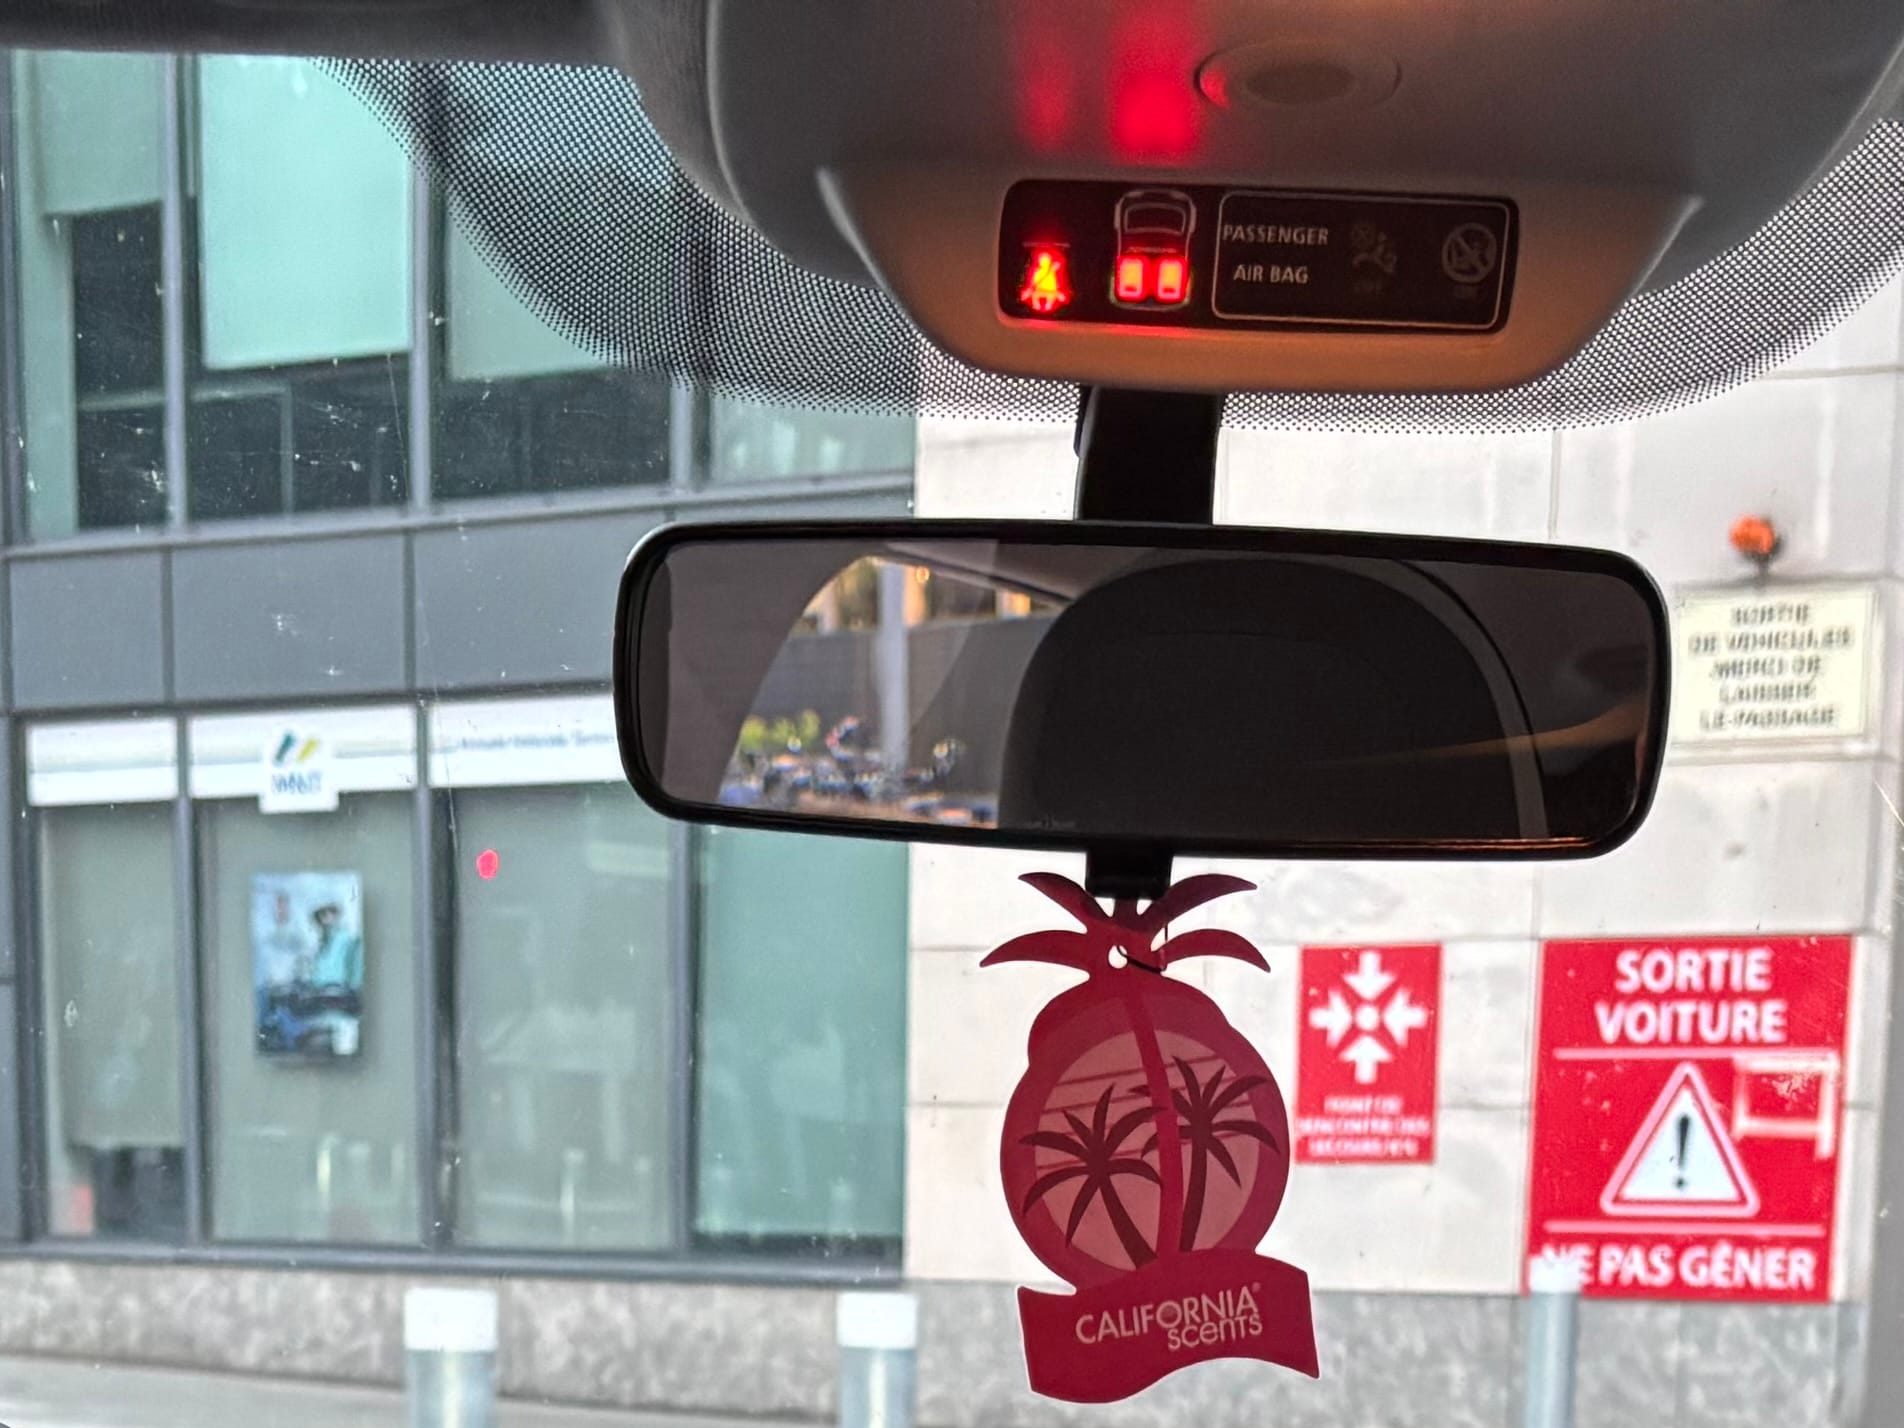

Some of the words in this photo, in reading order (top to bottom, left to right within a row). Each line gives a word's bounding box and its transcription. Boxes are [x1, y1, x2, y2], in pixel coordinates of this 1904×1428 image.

[1222, 223, 1329, 247] PASSENGER
[1233, 263, 1265, 284] AIR
[1269, 264, 1309, 286] BAG
[1615, 949, 1771, 993] SORTIE
[1595, 1002, 1788, 1044] VOITURE
[1600, 1245, 1673, 1288] PAS
[1679, 1239, 1817, 1289] GÊNER
[1075, 1286, 1258, 1345] CALIFORNIA
